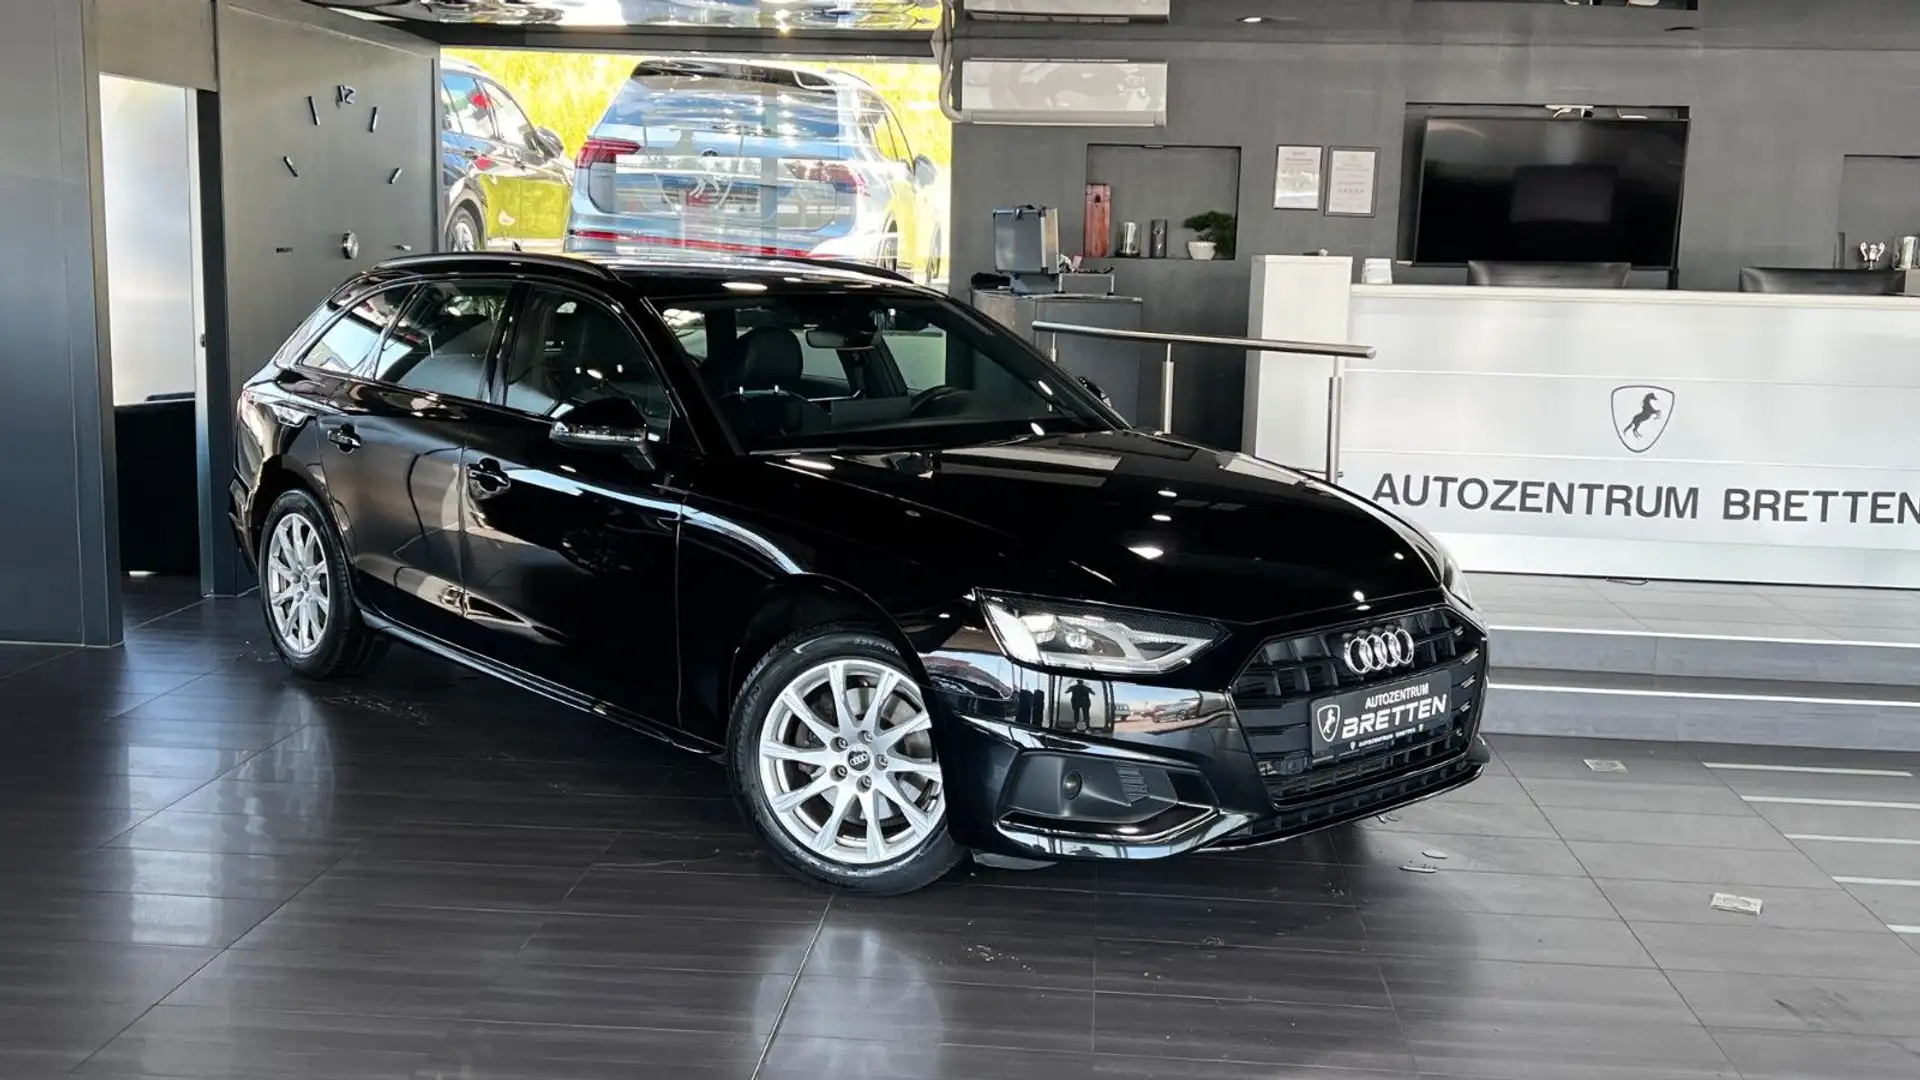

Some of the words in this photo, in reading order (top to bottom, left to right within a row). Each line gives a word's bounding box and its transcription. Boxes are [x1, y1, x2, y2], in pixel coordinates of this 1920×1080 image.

[1372, 473, 1699, 519] AUTOZENTRUM
[1722, 488, 1920, 524] BRETTEN
[1341, 693, 1448, 739] BRETTEN
[1365, 682, 1430, 710] AUTOZENTRUM
